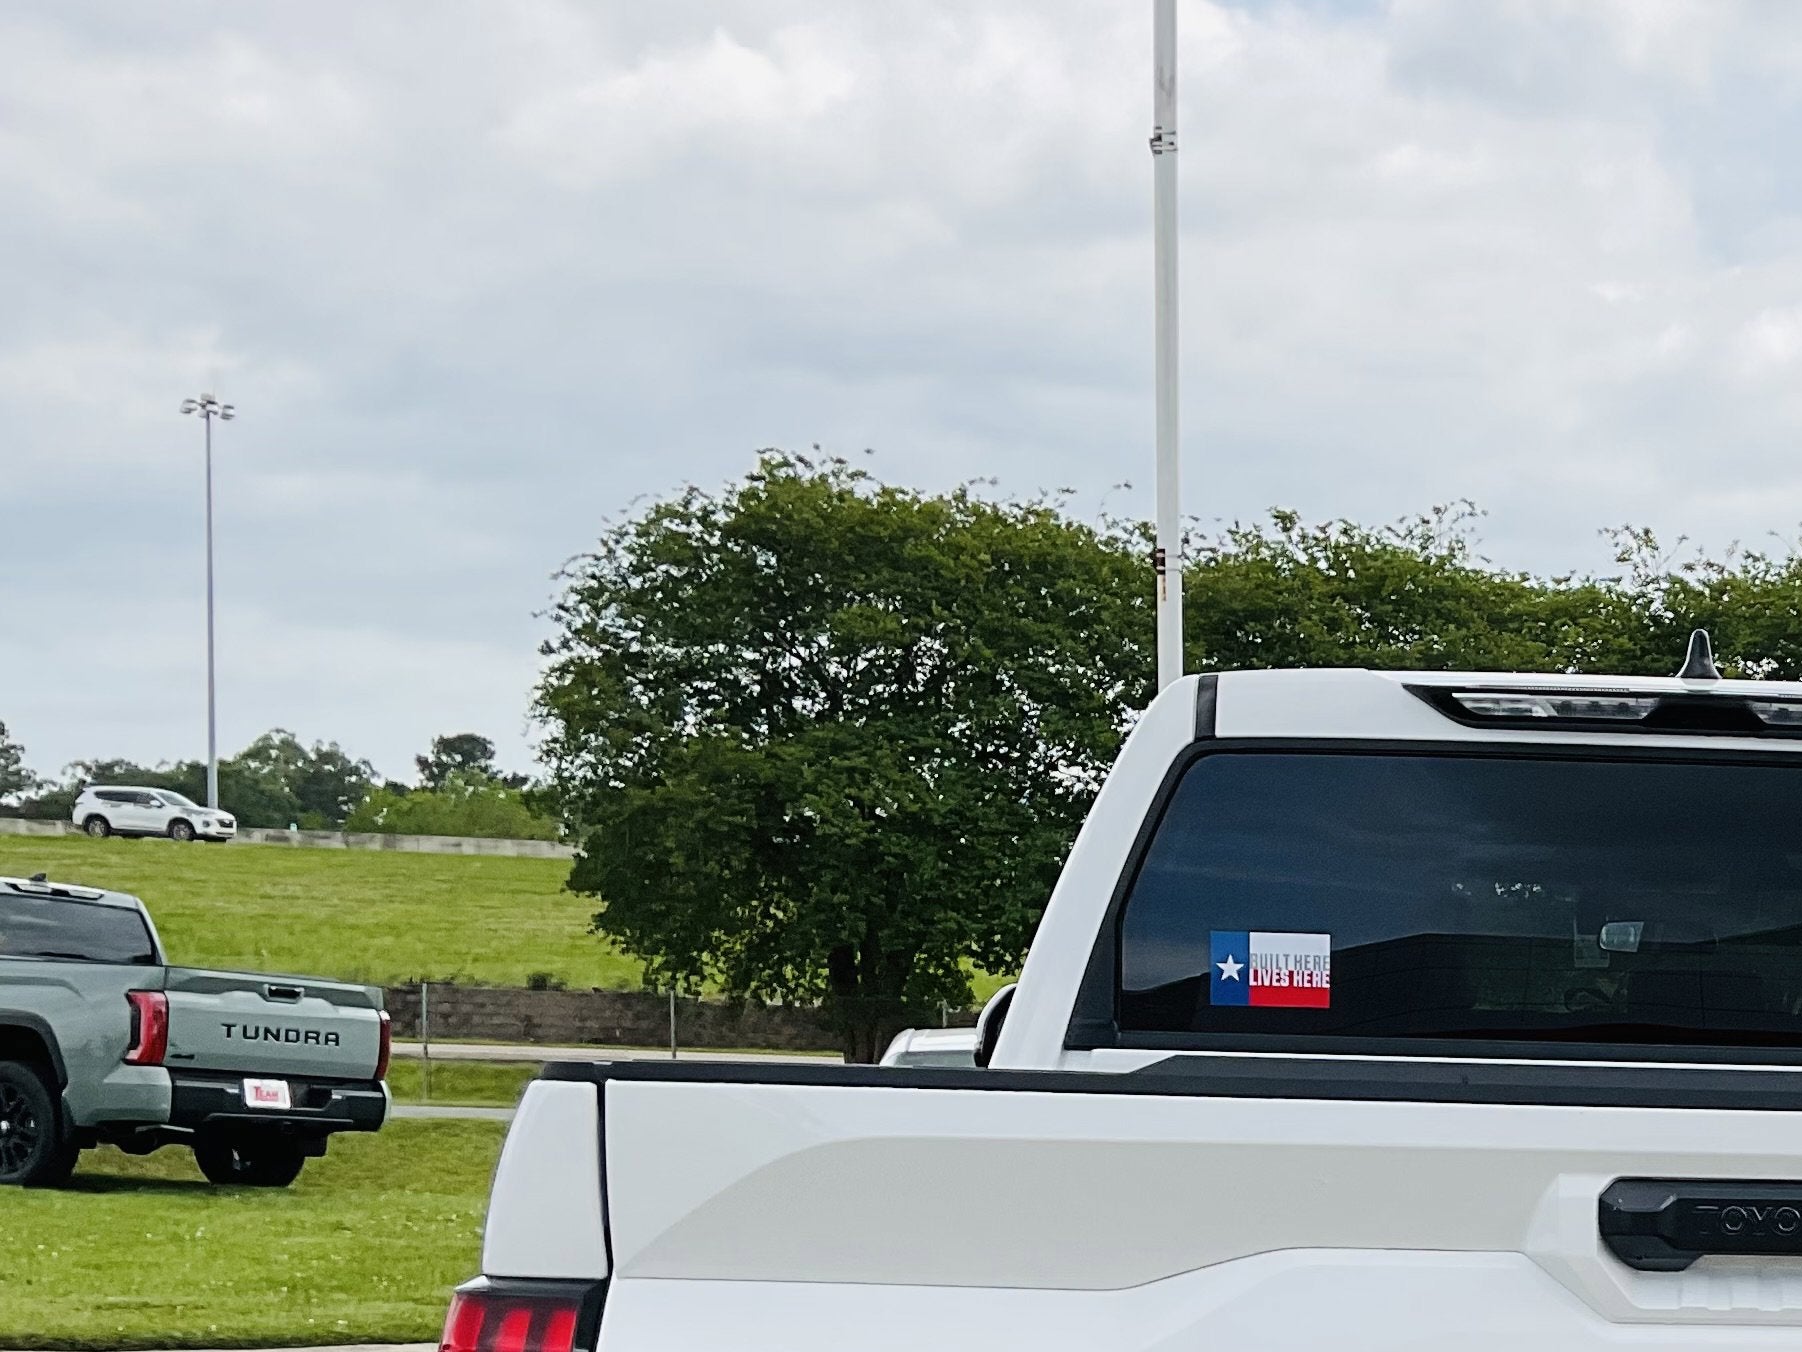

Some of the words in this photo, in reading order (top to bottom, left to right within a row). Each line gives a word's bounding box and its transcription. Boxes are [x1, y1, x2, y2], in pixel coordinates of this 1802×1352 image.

[1250, 953, 1290, 972] BUILT
[1294, 954, 1331, 972] HERE
[1249, 969, 1291, 988] LIVES
[1294, 970, 1331, 989] HERE
[221, 1023, 340, 1047] TUNDRA
